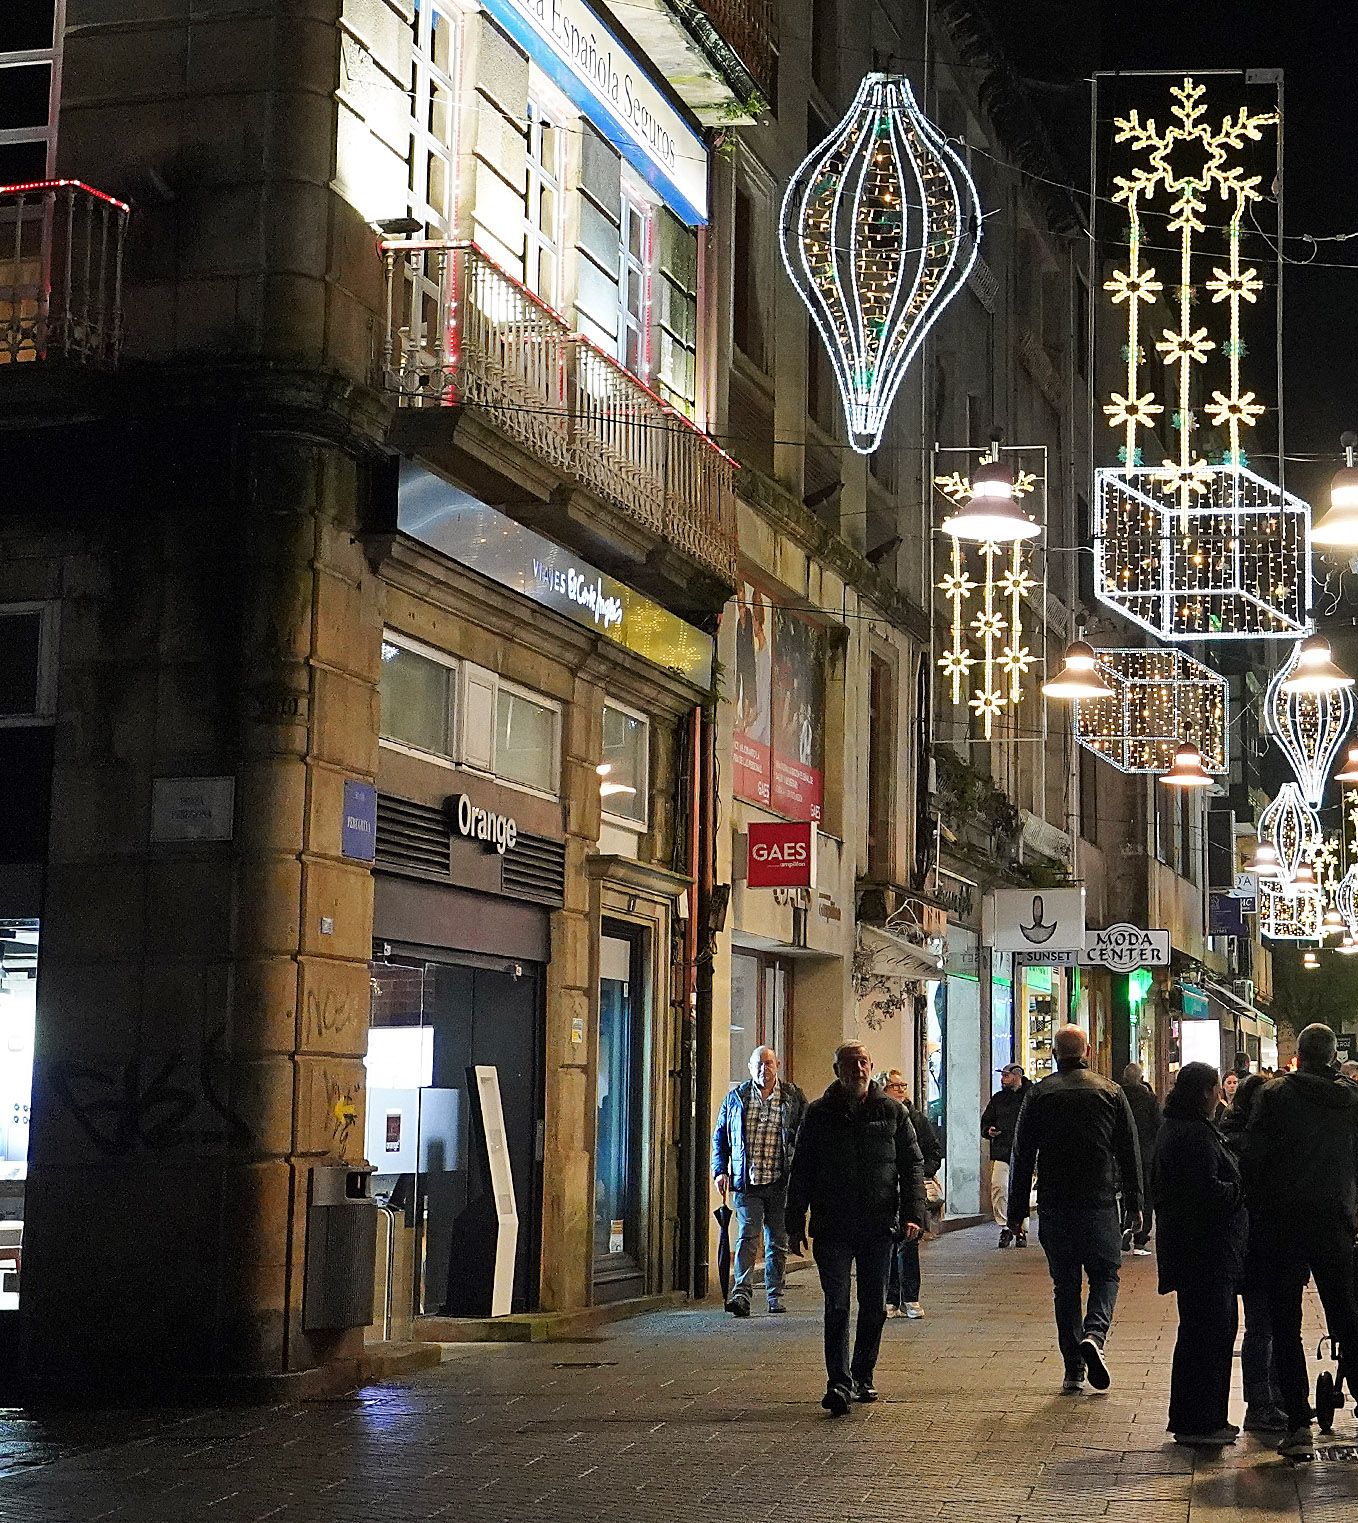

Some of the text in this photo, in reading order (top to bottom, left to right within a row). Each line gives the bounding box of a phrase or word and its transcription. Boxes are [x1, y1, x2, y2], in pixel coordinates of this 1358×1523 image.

[551, 0, 619, 105] Española
[623, 74, 676, 169] Seguros
[532, 558, 566, 594] VIAJES
[458, 793, 517, 855] Orange
[752, 842, 807, 861] GAES
[780, 861, 806, 869] amplifon
[1096, 932, 1153, 947] MODA
[1026, 951, 1073, 962] SUNSET
[1086, 948, 1163, 963] CENTER
